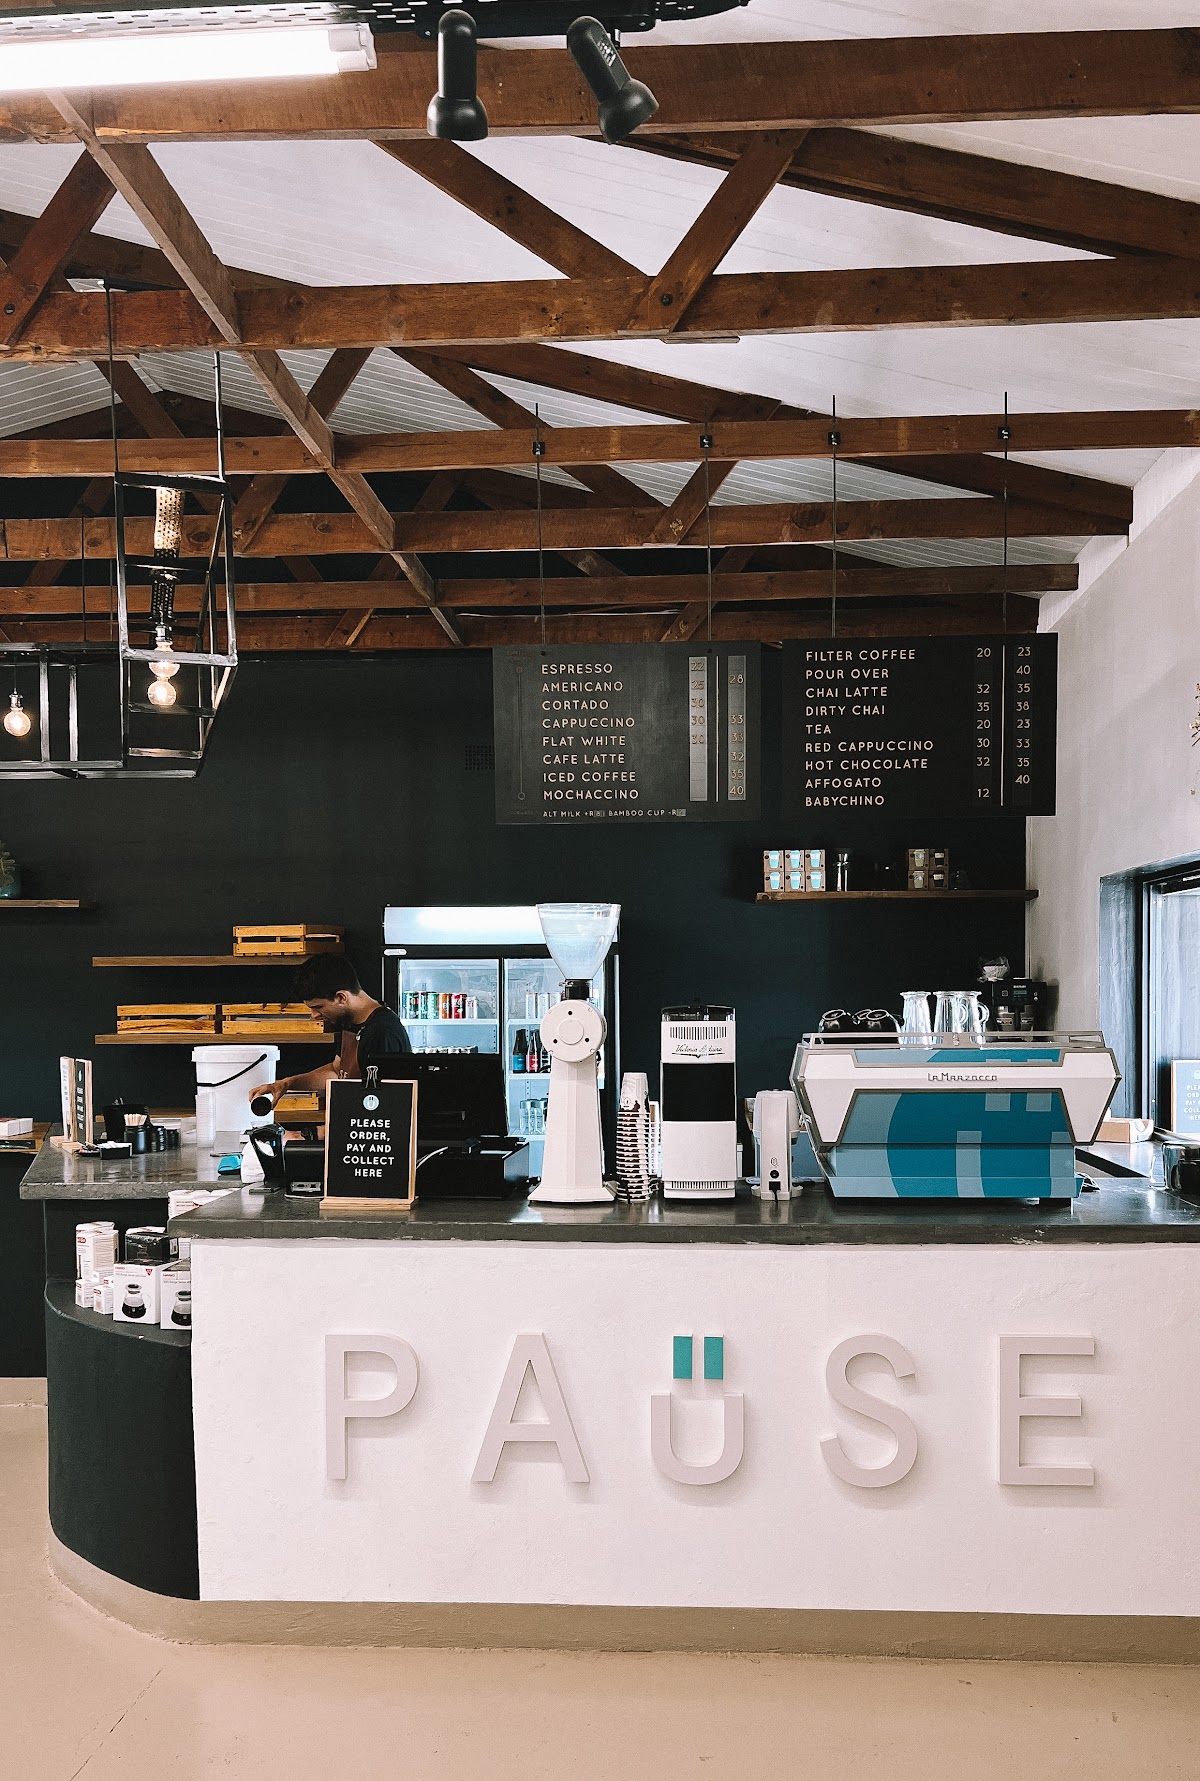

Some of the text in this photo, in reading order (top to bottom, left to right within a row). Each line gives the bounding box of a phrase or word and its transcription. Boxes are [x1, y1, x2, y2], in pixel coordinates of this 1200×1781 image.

[806, 647, 1030, 661] FILTER COFFEE 20 23
[541, 664, 612, 674] ESPRESSO
[805, 665, 1030, 679] POUR OVER 40
[541, 681, 623, 692] AMERICANO
[729, 674, 744, 684] 28
[805, 684, 1030, 698] CHAI LATTE 32 35
[541, 700, 608, 710] CORTADO
[805, 702, 1029, 716] DIRTY CHAI 35 38
[541, 717, 634, 728] CAPPUCCINO
[731, 714, 744, 724] 33
[805, 719, 1030, 734] TEA 20 23
[542, 737, 574, 746] FLAT
[580, 736, 625, 746] WHITE
[805, 738, 1029, 752] RED CAPPUCCINO 30 33
[542, 752, 744, 764] CAFE LATTE 32
[805, 757, 1029, 770] HOT CHOCOLATE 32 35
[543, 769, 744, 782] ICED COFFEE 35
[805, 775, 1030, 788] AFFOGATO 40
[543, 786, 744, 800] MOCHACCINO 40
[805, 789, 989, 806] BABYCHINO 12
[561, 810, 581, 818] MILK
[608, 809, 644, 817] BAMBOO
[350, 1119, 390, 1128] PLEASE
[349, 1131, 390, 1141] ORDER,
[346, 1144, 391, 1153] PAY AND
[342, 1156, 394, 1165] COLLECT
[354, 1168, 382, 1177] HERE
